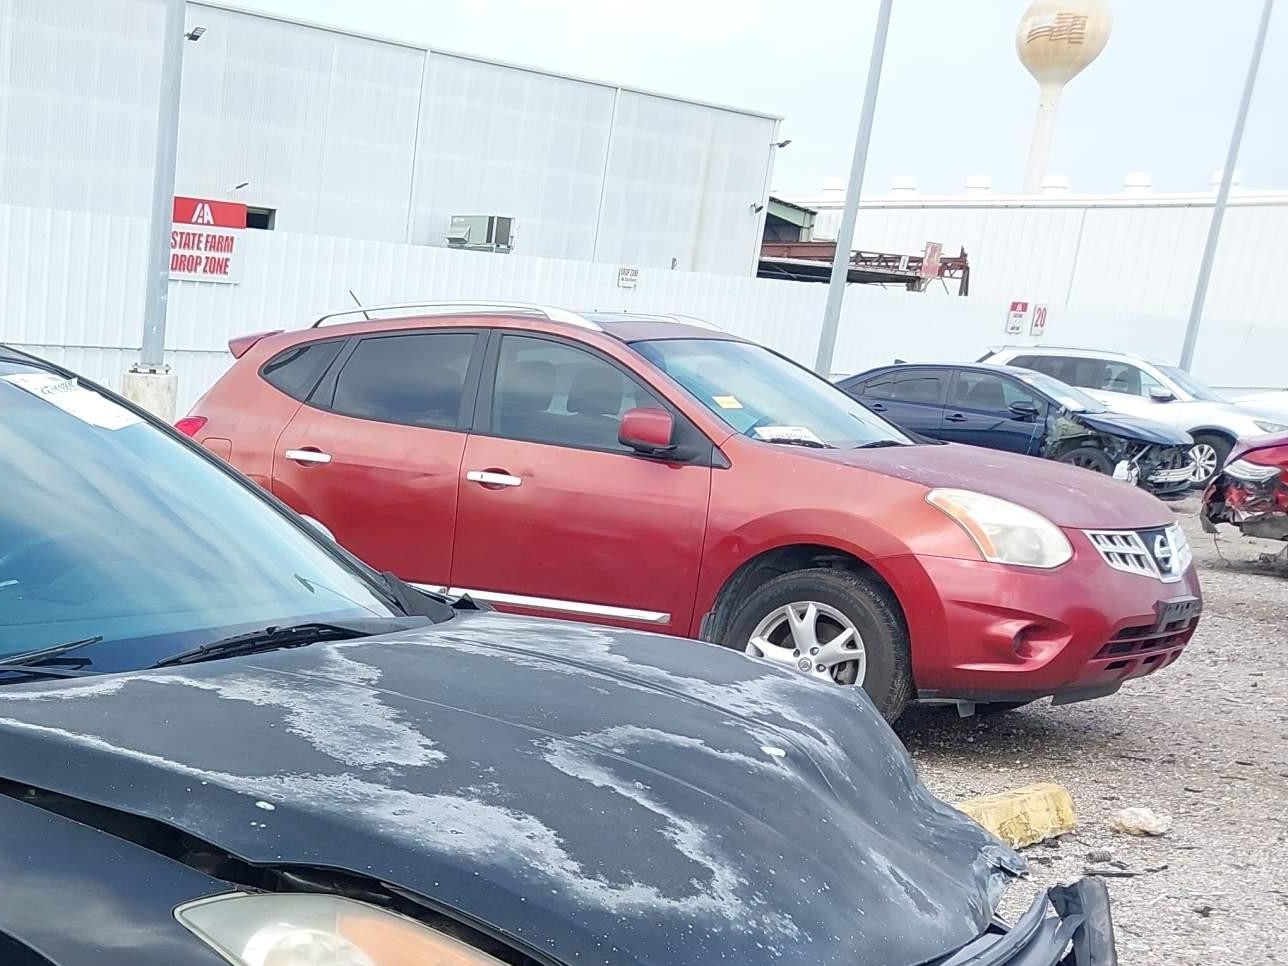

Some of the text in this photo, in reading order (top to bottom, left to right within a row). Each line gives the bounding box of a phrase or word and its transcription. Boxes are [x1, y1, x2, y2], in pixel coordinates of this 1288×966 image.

[170, 231, 234, 253] STATE FARM
[171, 253, 230, 275] DROP ZONE
[1034, 307, 1047, 328] 20
